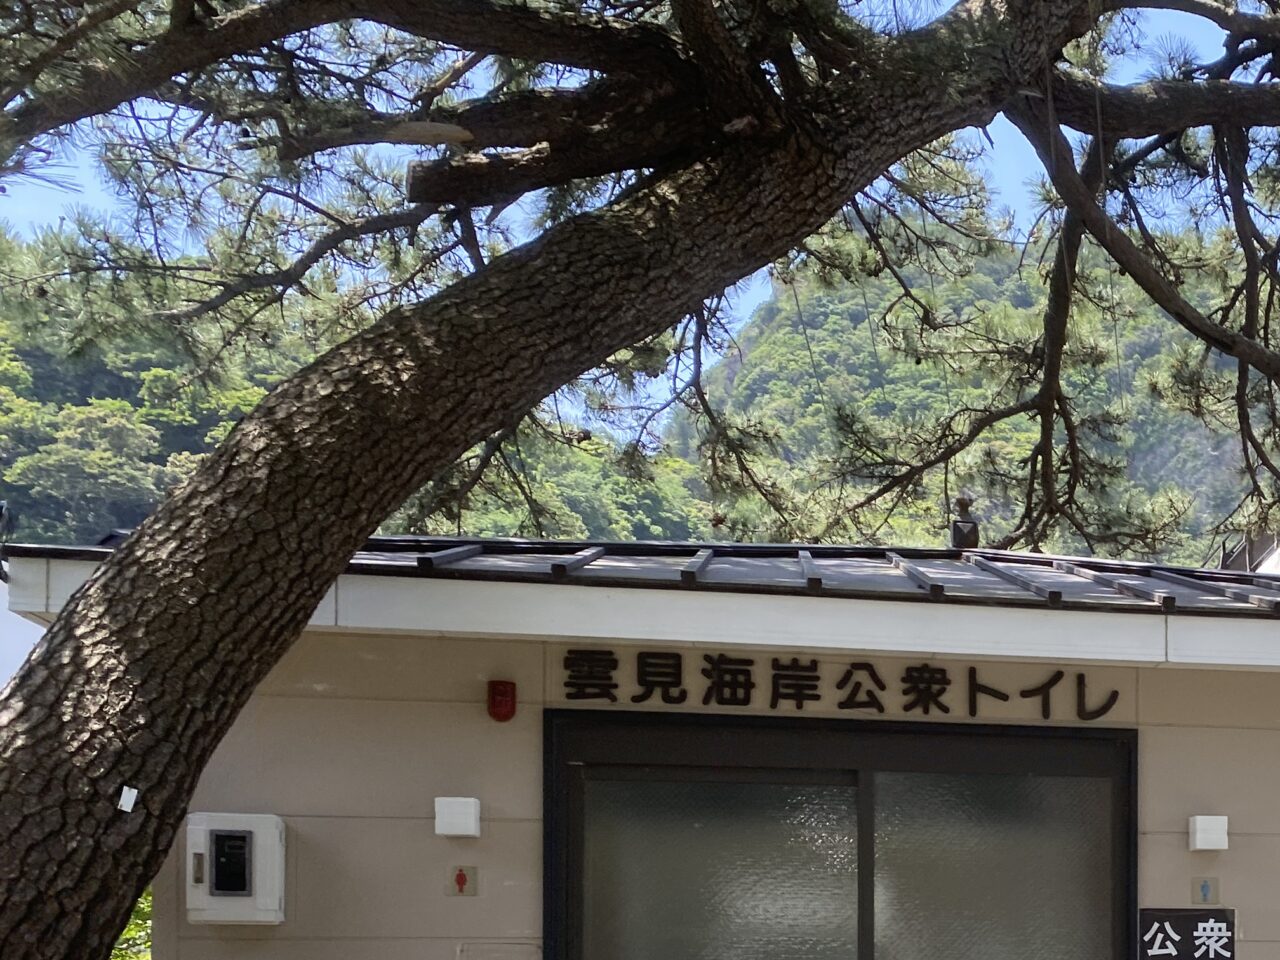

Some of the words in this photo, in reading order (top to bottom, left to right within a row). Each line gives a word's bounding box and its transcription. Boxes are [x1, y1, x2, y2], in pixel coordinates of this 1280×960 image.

[563, 649, 1119, 721] 雲見海岸公衆トイレ
[1142, 918, 1232, 959] 公衆
